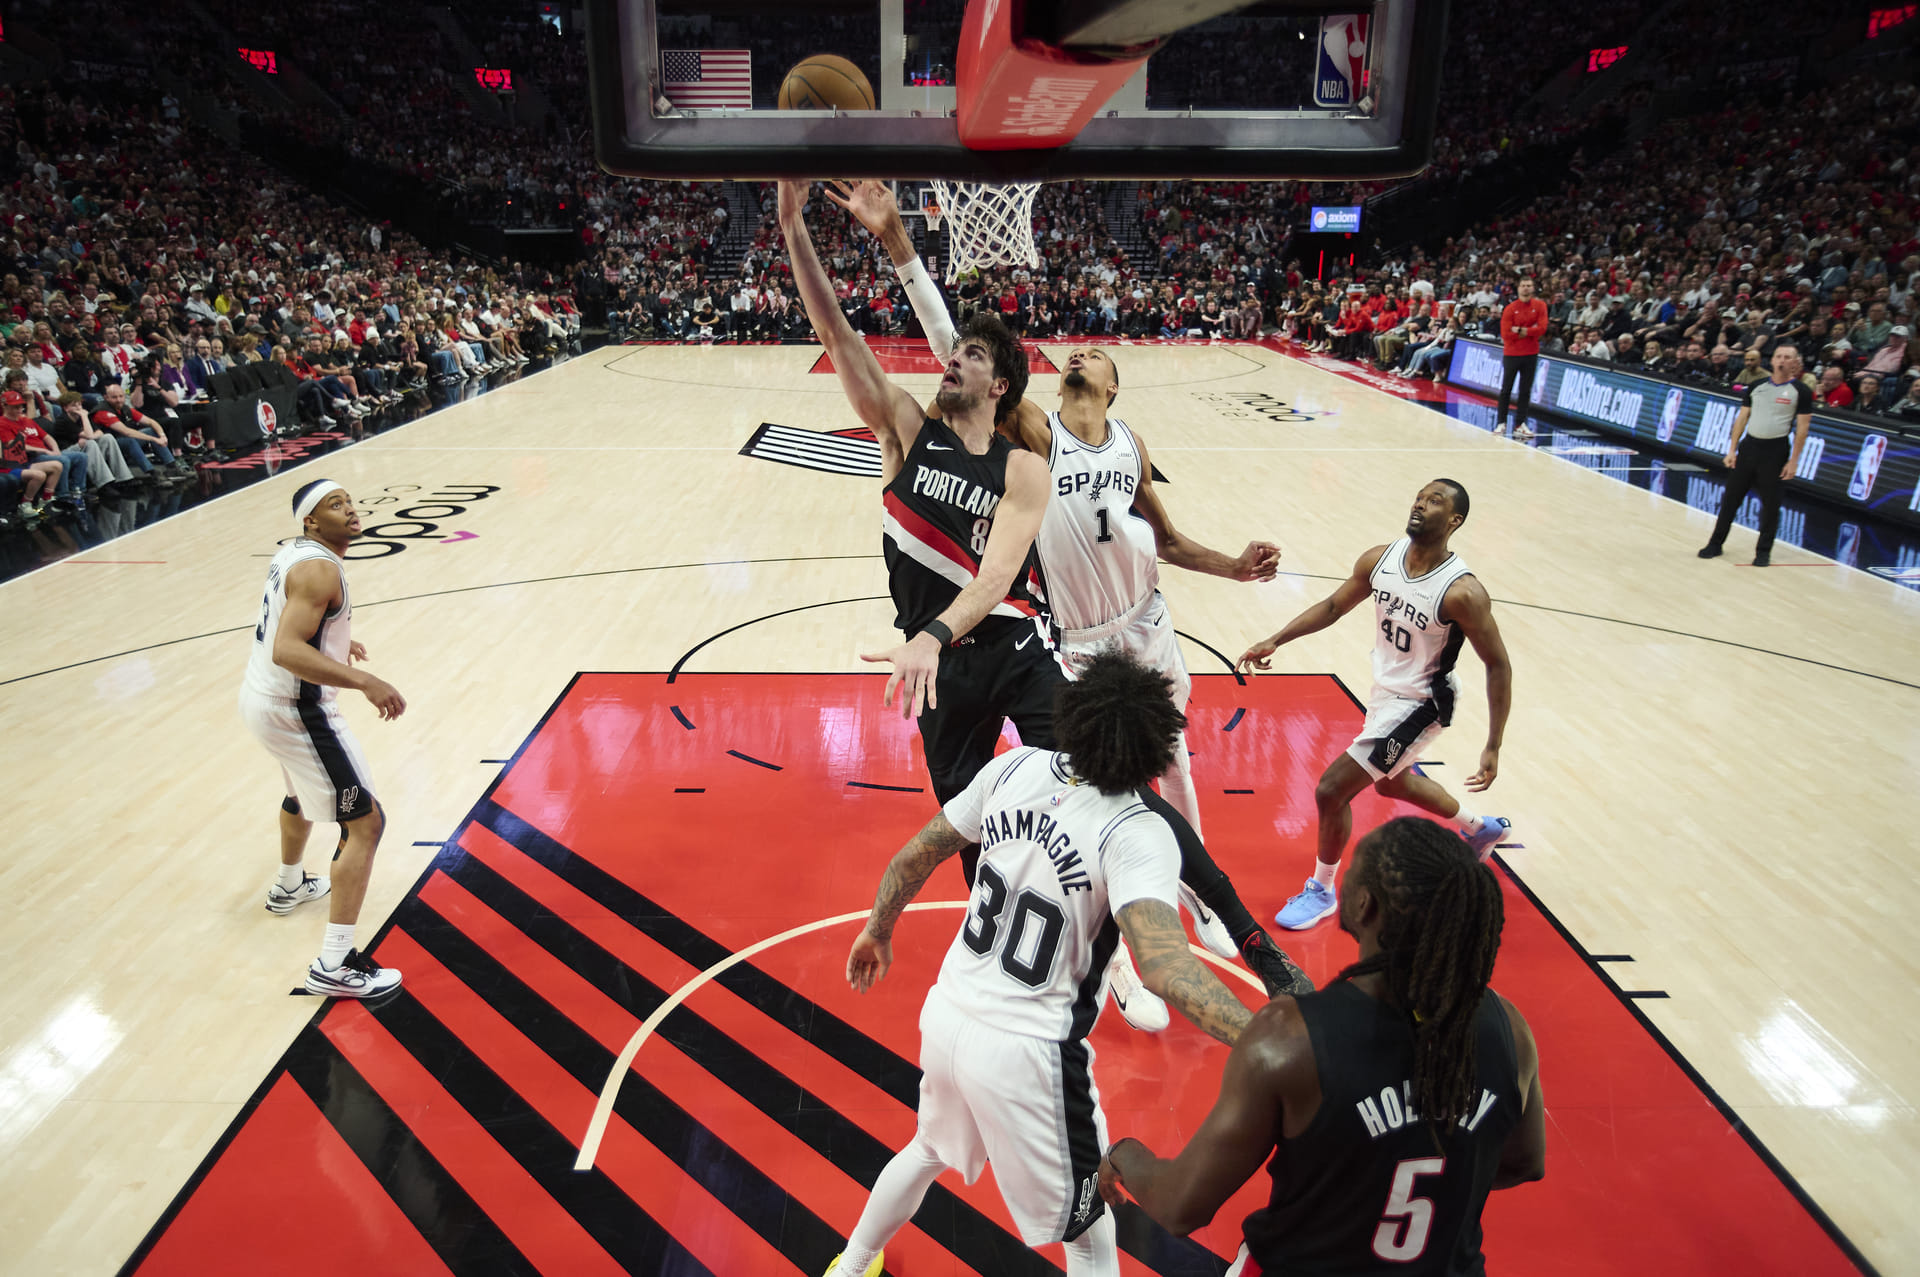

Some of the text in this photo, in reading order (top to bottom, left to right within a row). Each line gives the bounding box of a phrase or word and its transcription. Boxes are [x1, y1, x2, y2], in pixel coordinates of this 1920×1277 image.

[1321, 80, 1344, 99] NBA
[1328, 211, 1357, 223] axiom
[1556, 367, 1643, 429] NBAStore.com
[913, 464, 1000, 520] PORTLAN
[1058, 470, 1135, 502] SPURS
[1096, 507, 1113, 545] 1
[1381, 618, 1411, 653] 40
[980, 809, 1093, 896] CHAMPAGNIE
[962, 858, 1068, 992] 30
[1356, 1080, 1497, 1137] HOLY
[1371, 1156, 1447, 1263] 5
